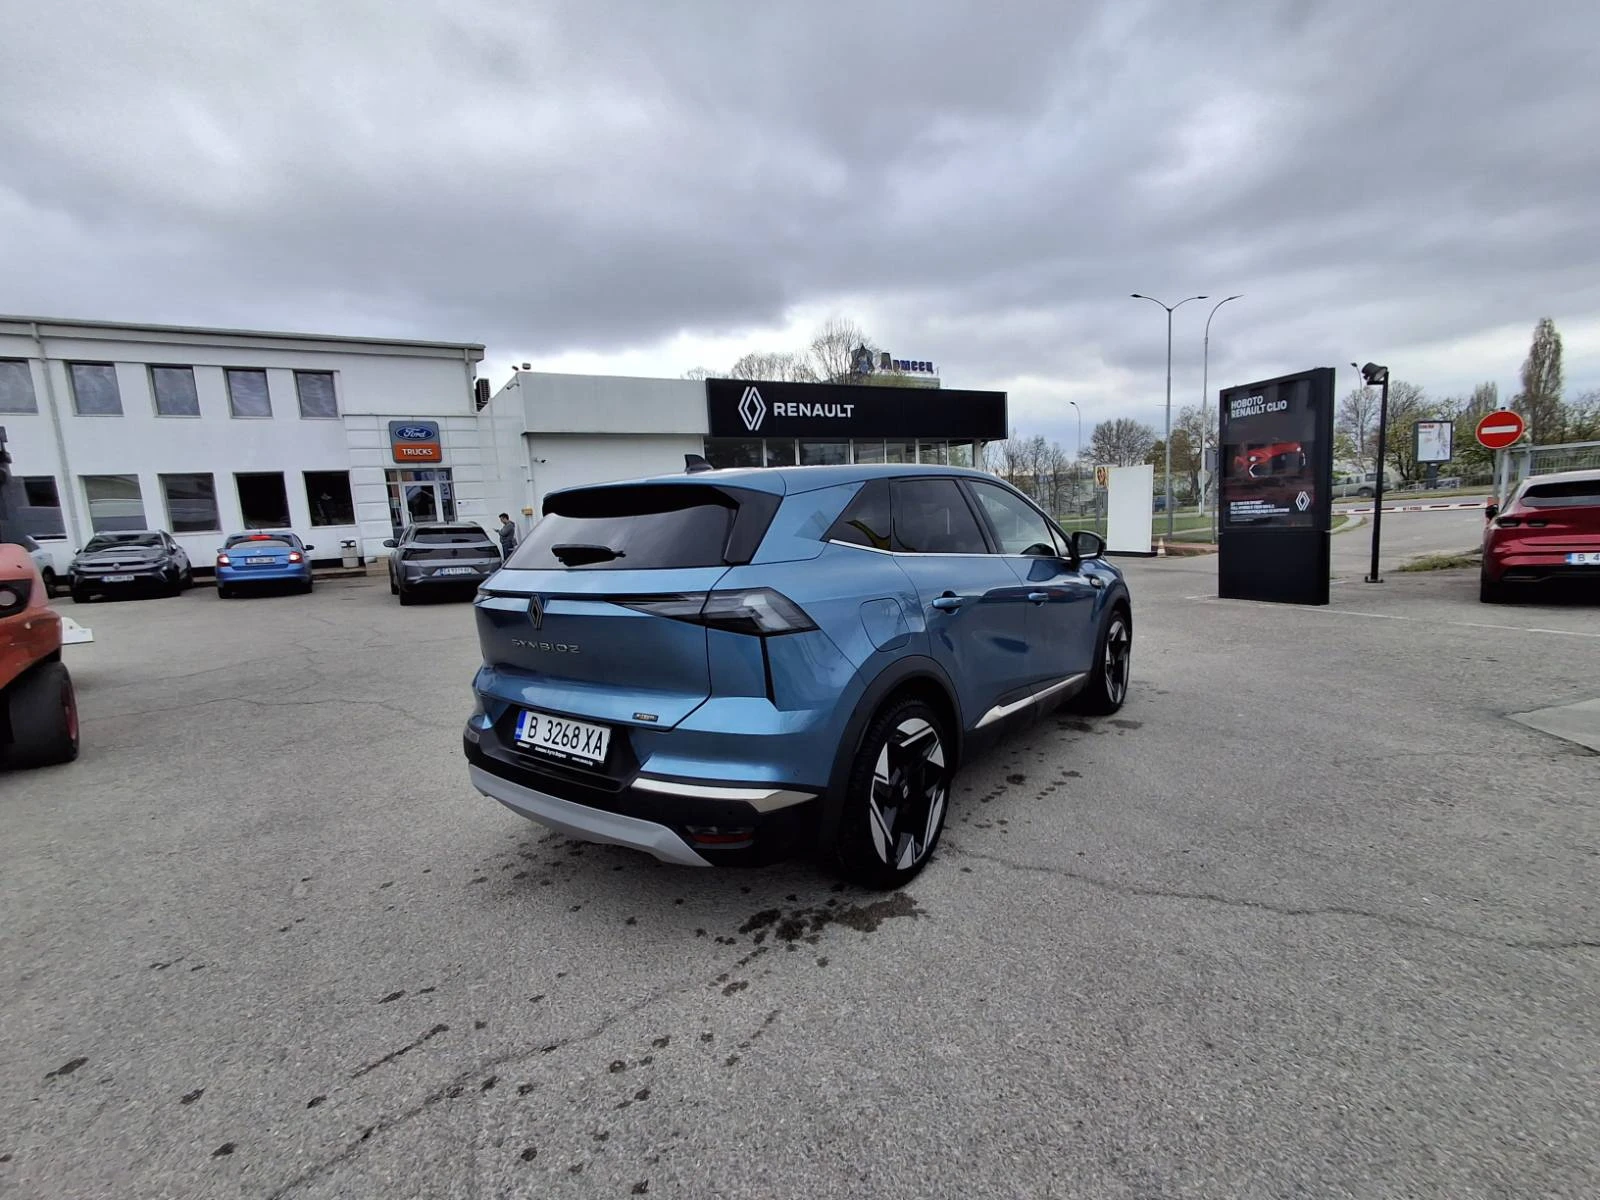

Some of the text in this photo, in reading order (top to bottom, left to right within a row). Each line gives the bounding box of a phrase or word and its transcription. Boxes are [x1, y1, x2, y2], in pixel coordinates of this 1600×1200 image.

[1231, 395, 1264, 409] НОВОТО
[773, 402, 855, 418] RENAULT
[1231, 400, 1288, 419] RENAULT CLIO
[403, 427, 427, 438] Ford
[402, 448, 433, 456] TRUCKS
[1577, 553, 1586, 562] B
[528, 716, 605, 757] B 3268 XA
